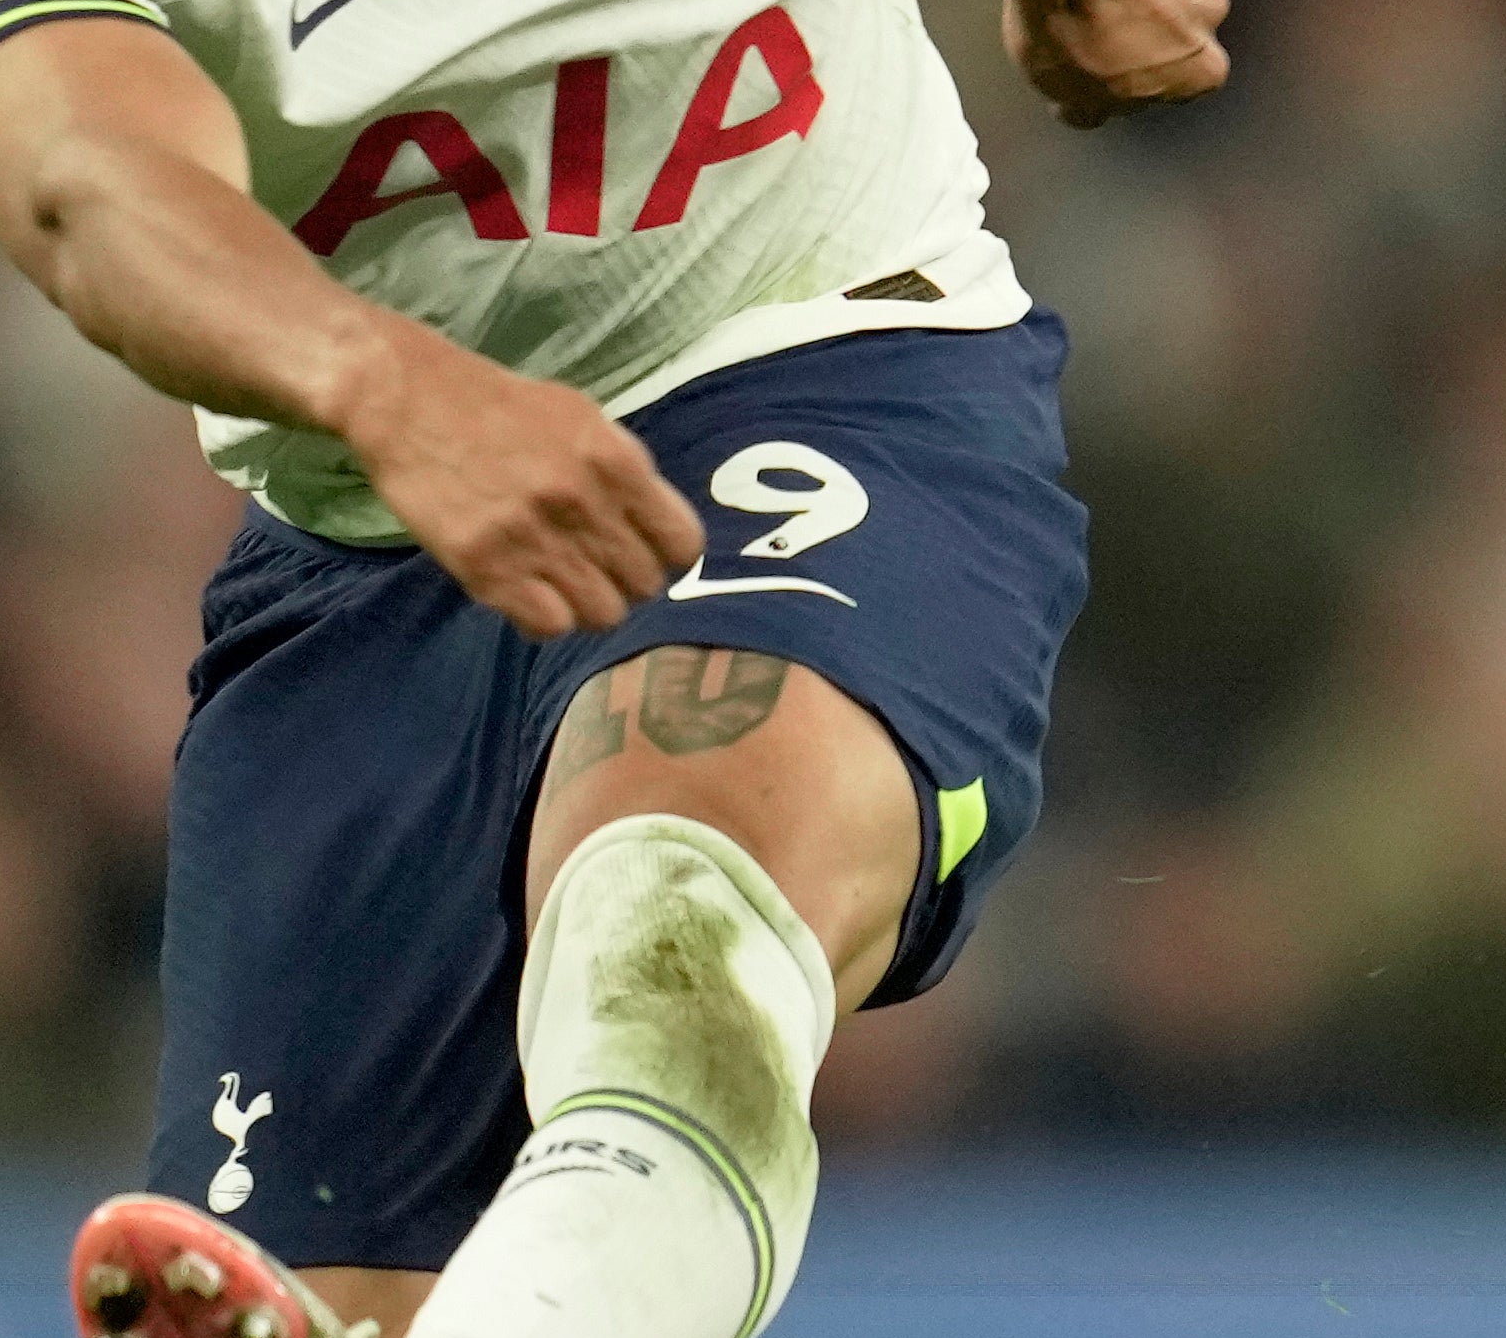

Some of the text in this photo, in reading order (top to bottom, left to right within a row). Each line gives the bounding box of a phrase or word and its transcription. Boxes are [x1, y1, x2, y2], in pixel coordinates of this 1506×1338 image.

[291, 4, 825, 257] AIA
[709, 439, 869, 560] 9
[516, 1138, 659, 1178] URS
